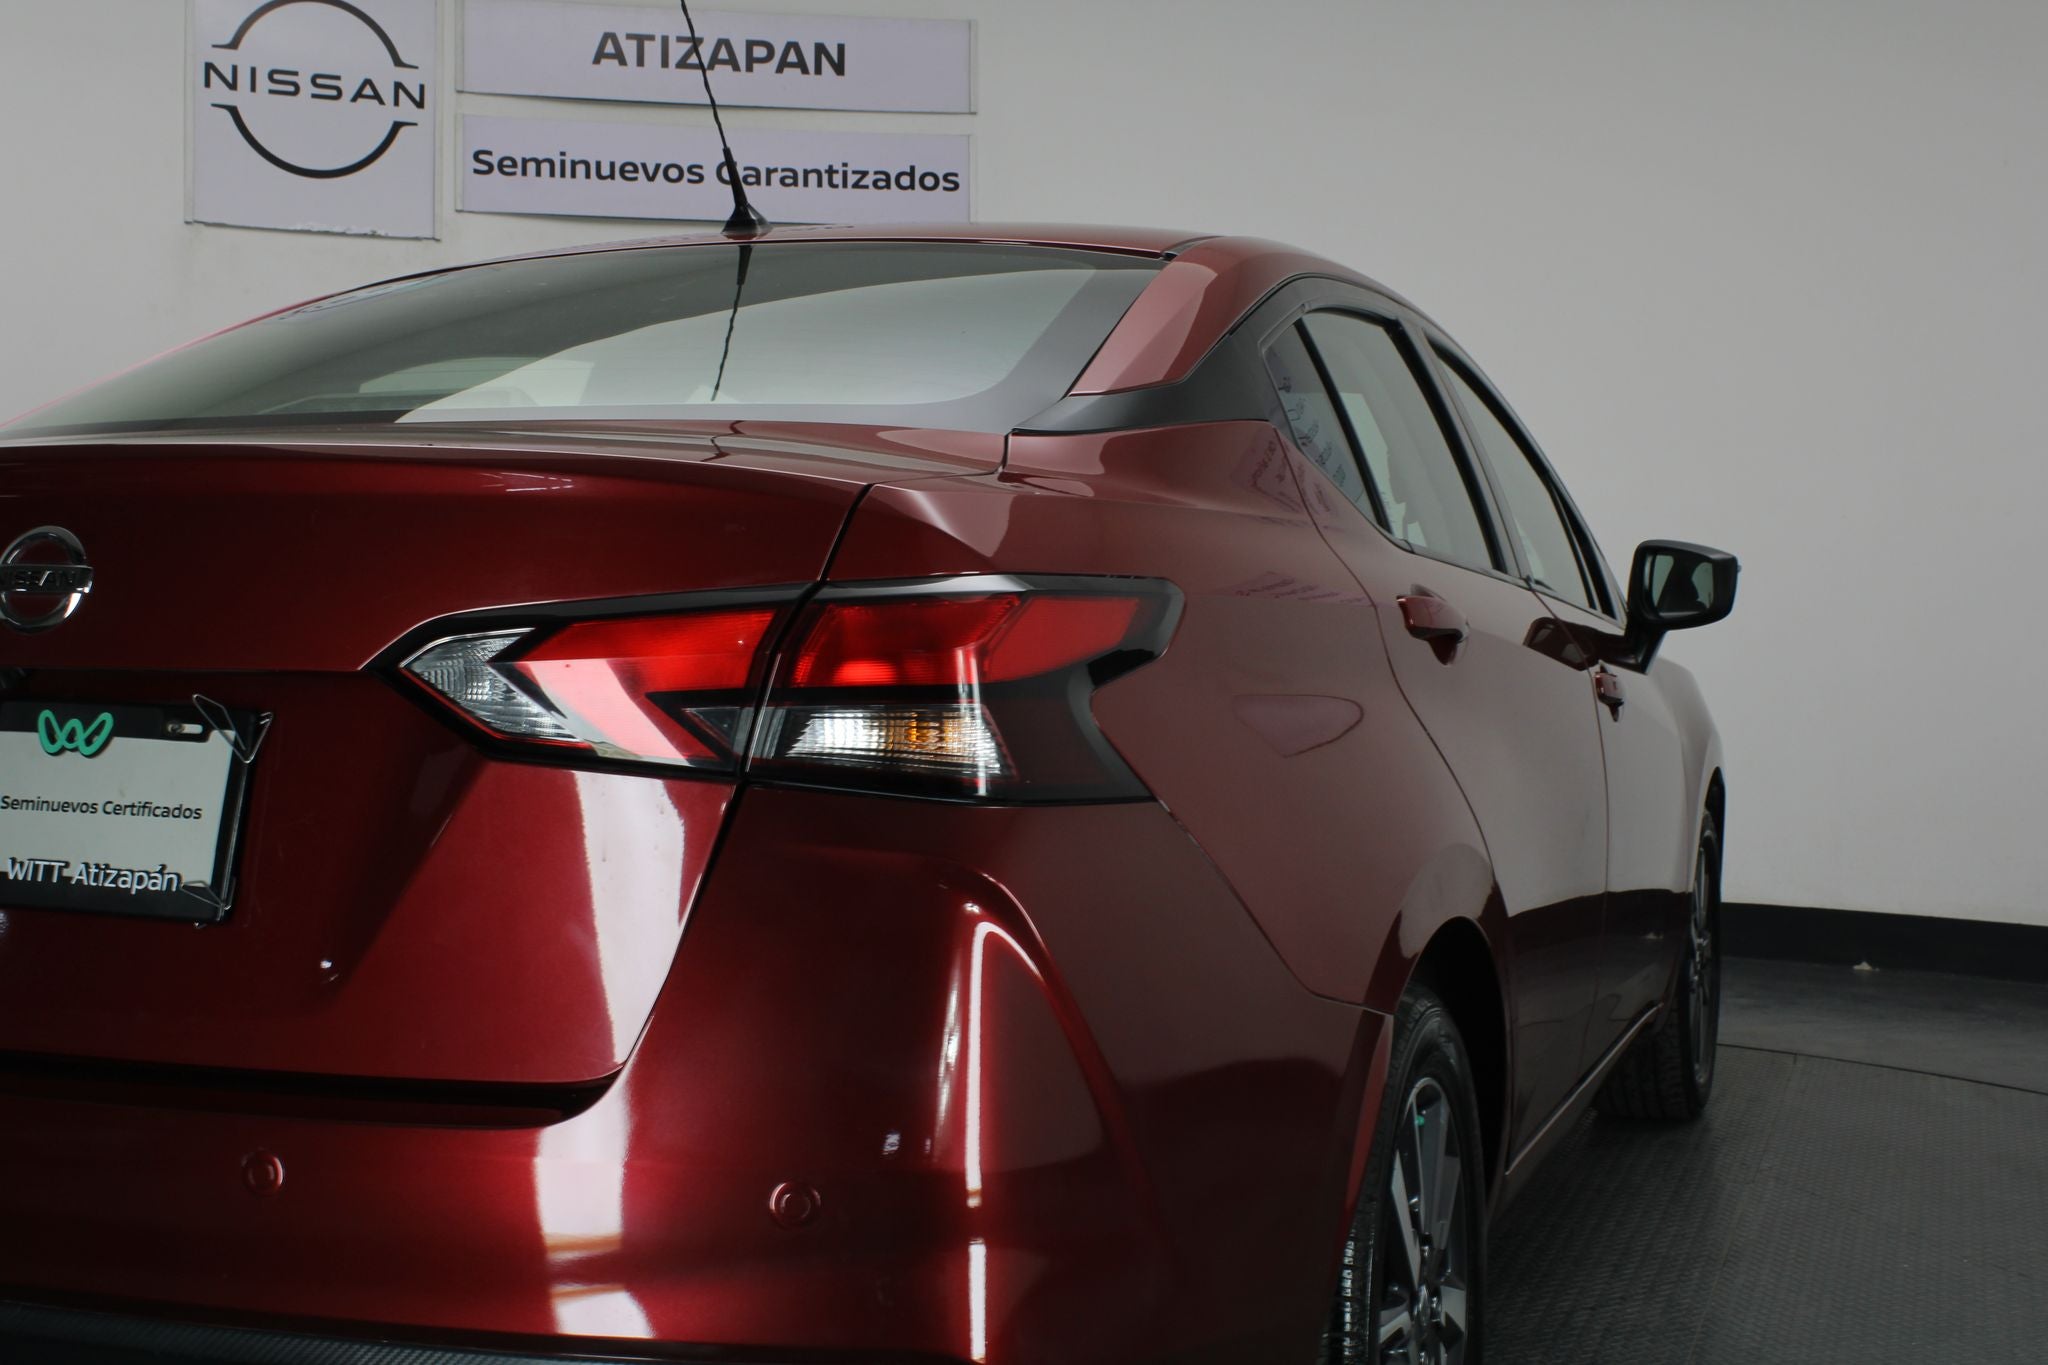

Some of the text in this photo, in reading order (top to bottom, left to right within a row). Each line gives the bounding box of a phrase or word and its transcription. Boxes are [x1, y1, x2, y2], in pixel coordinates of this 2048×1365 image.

[591, 31, 846, 77] ATIZAPAN
[204, 61, 425, 110] NISSAN
[472, 149, 961, 192] Seminuevos Garantizados
[0, 795, 202, 820] Seminuevos Certificados
[7, 857, 180, 895] WITT Atizapán
